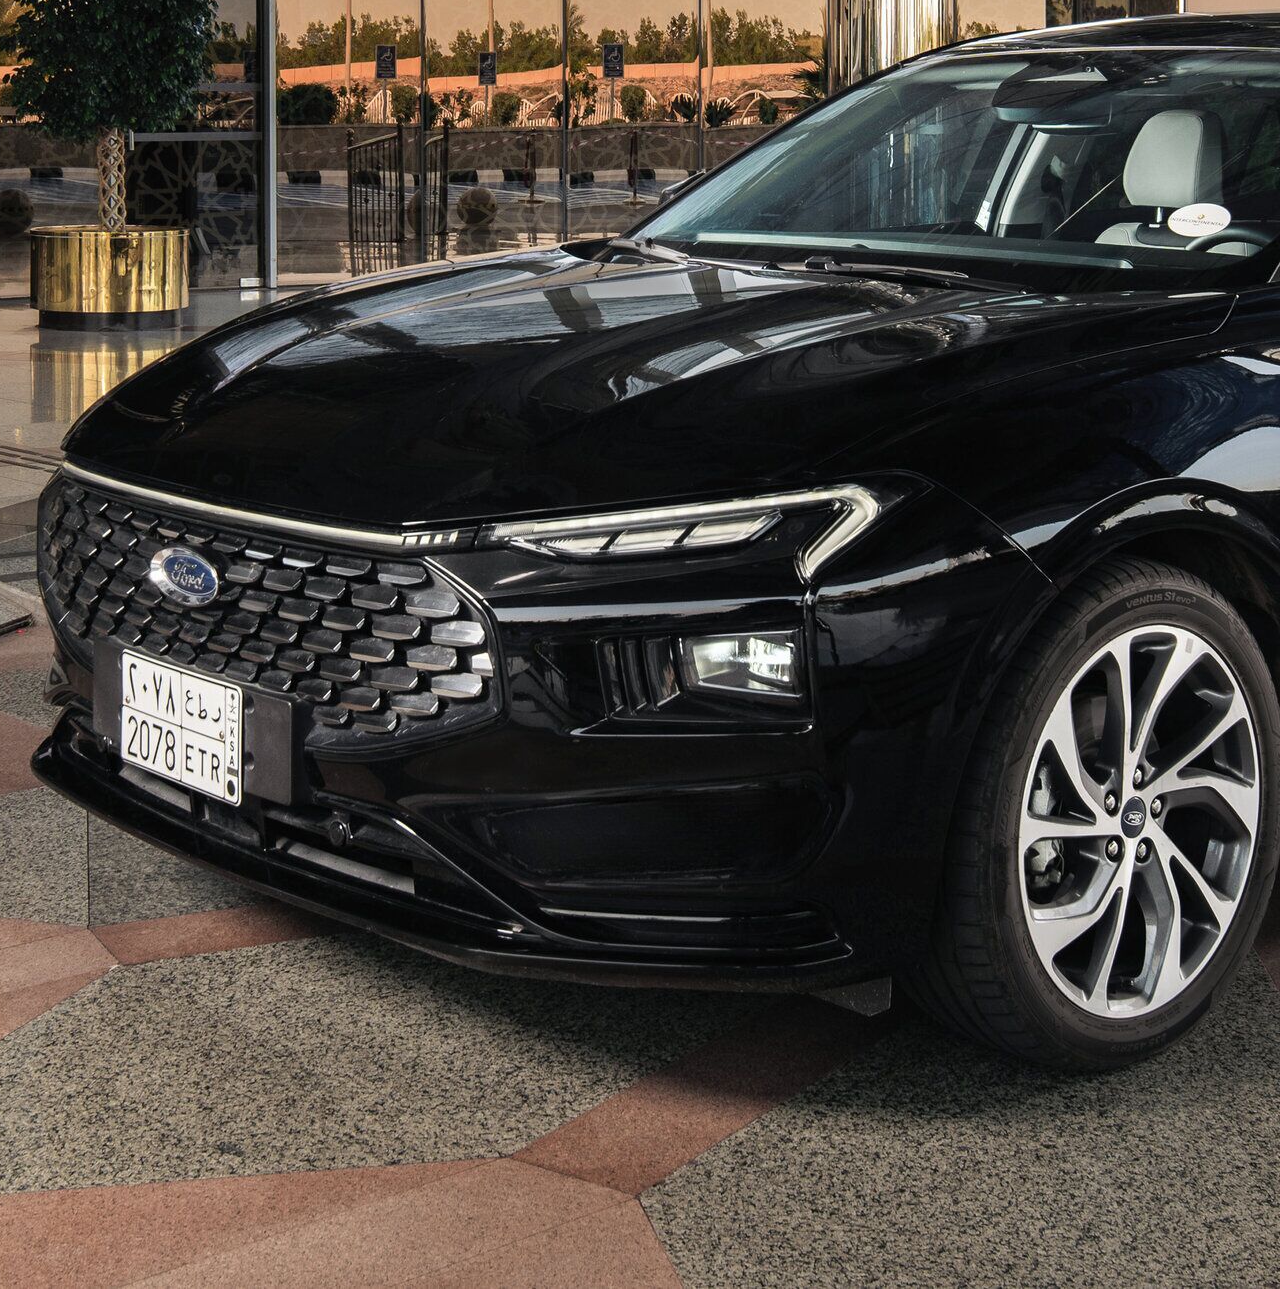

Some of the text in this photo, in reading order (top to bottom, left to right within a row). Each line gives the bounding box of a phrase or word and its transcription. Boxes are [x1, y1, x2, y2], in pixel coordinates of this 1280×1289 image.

[171, 559, 206, 590] Ford
[127, 715, 220, 783] 2078 ETR
